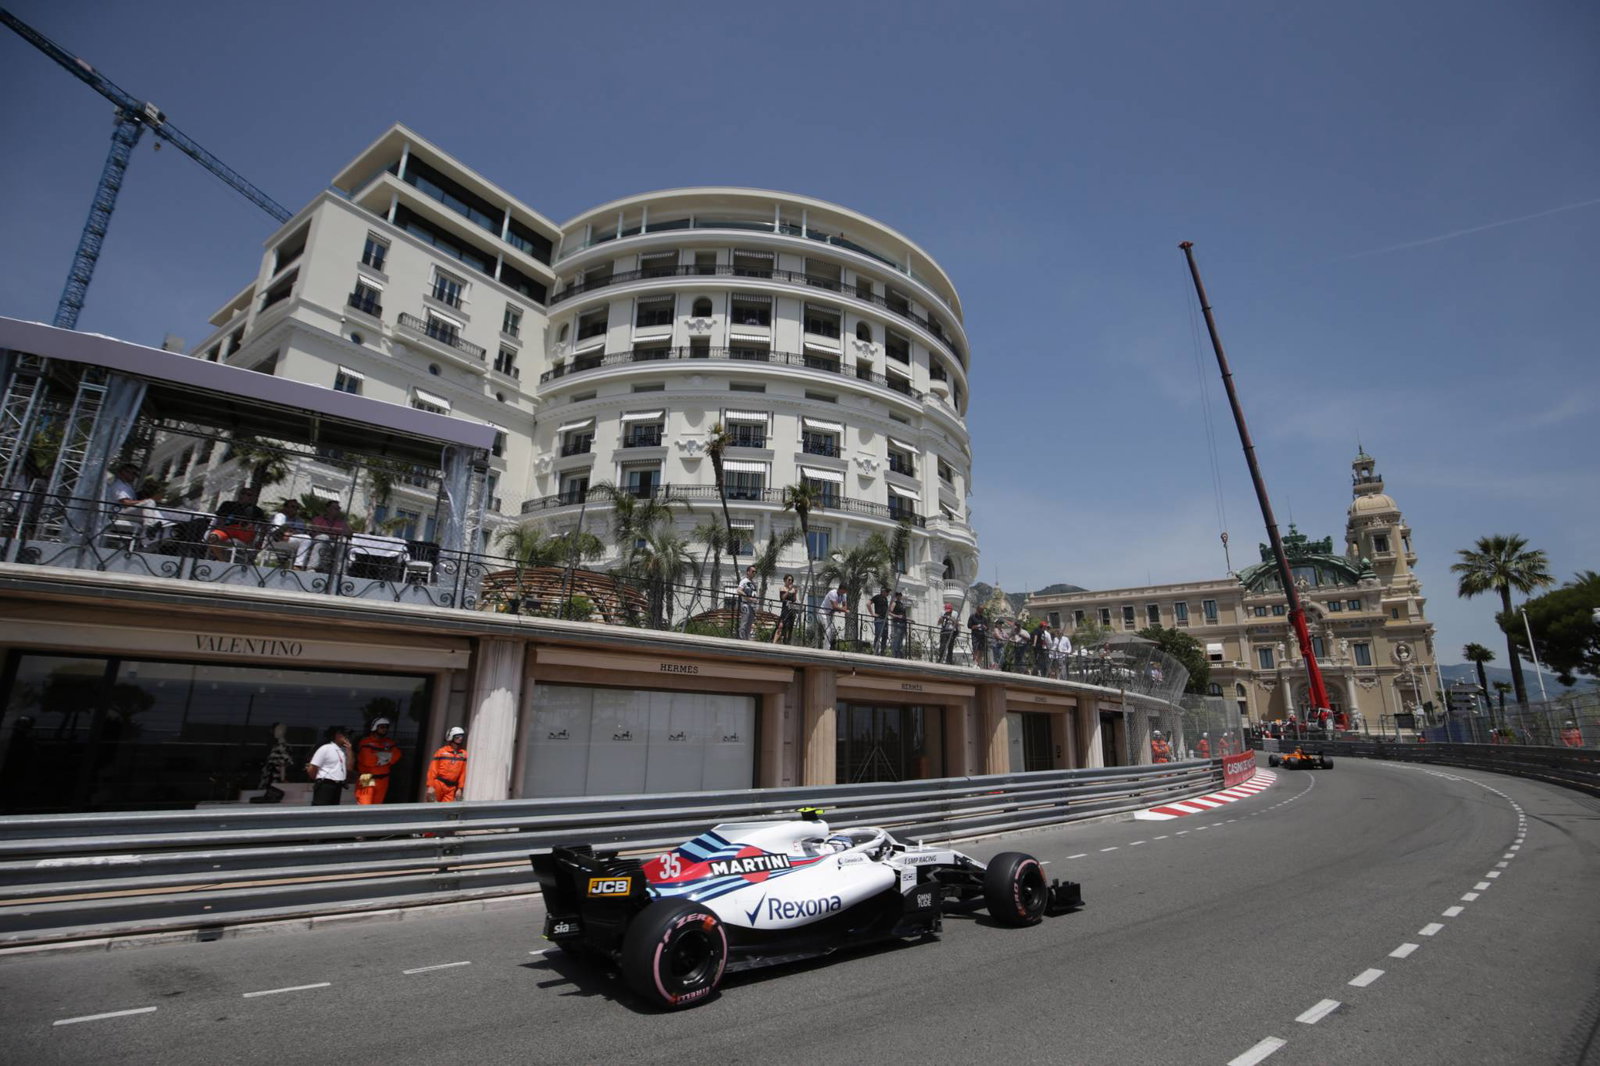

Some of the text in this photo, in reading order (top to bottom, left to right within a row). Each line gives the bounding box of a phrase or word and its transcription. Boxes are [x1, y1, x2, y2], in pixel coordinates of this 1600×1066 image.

[194, 635, 303, 656] VALENTINO
[660, 853, 681, 879] 35
[711, 855, 790, 876] MARTINI
[919, 855, 937, 863] RACING
[592, 881, 628, 893] JCB
[768, 896, 842, 920] Rexona
[554, 922, 570, 934] sia
